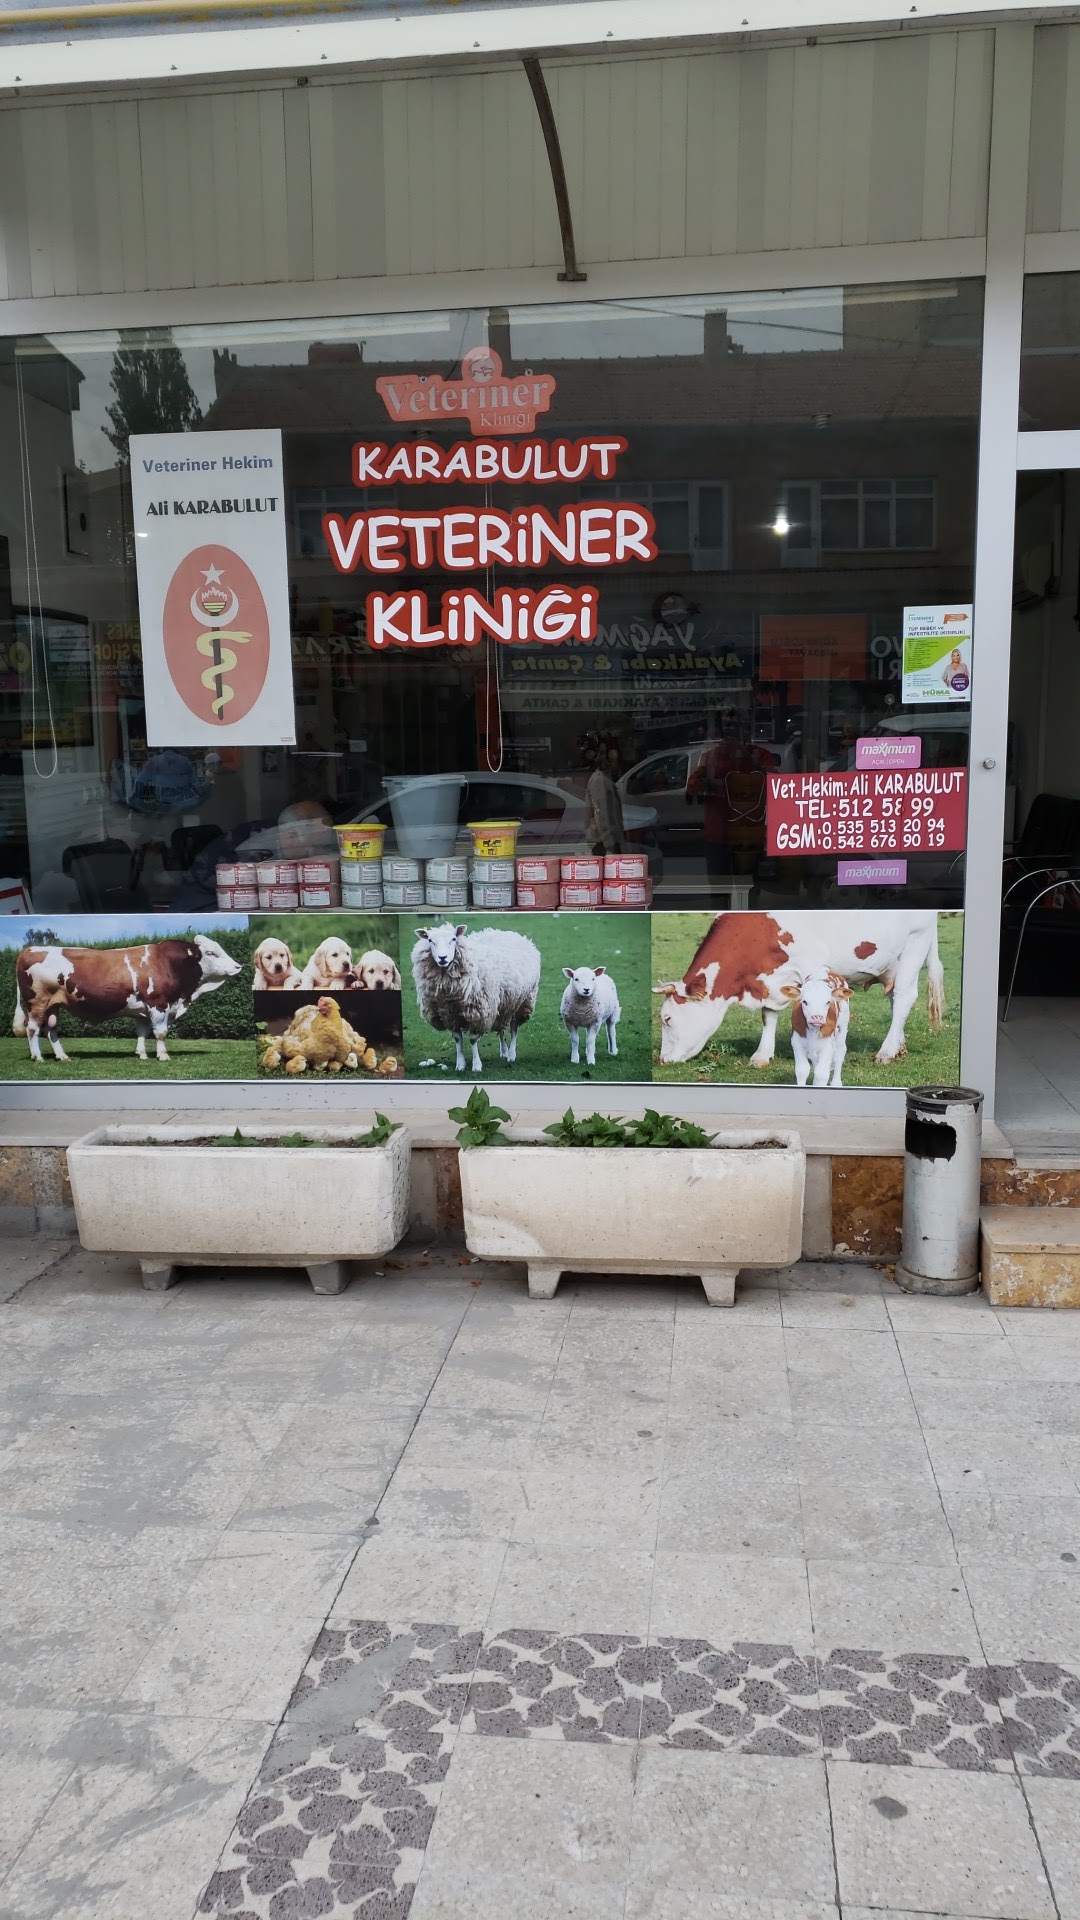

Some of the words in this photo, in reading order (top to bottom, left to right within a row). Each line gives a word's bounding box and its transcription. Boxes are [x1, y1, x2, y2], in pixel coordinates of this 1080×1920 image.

[142, 458, 217, 473] Veteriner
[222, 455, 273, 470] Hekim
[358, 443, 621, 482] KARABULUT
[147, 501, 169, 516] Ali
[173, 498, 278, 515] KARABULUT
[874, 772, 964, 796] KARABULUT
[911, 797, 934, 817] 99
[870, 819, 897, 833] 513
[903, 818, 921, 833] 20
[927, 817, 945, 832] 94
[870, 834, 897, 848] 676
[903, 834, 921, 847] 90
[928, 833, 945, 847] 19
